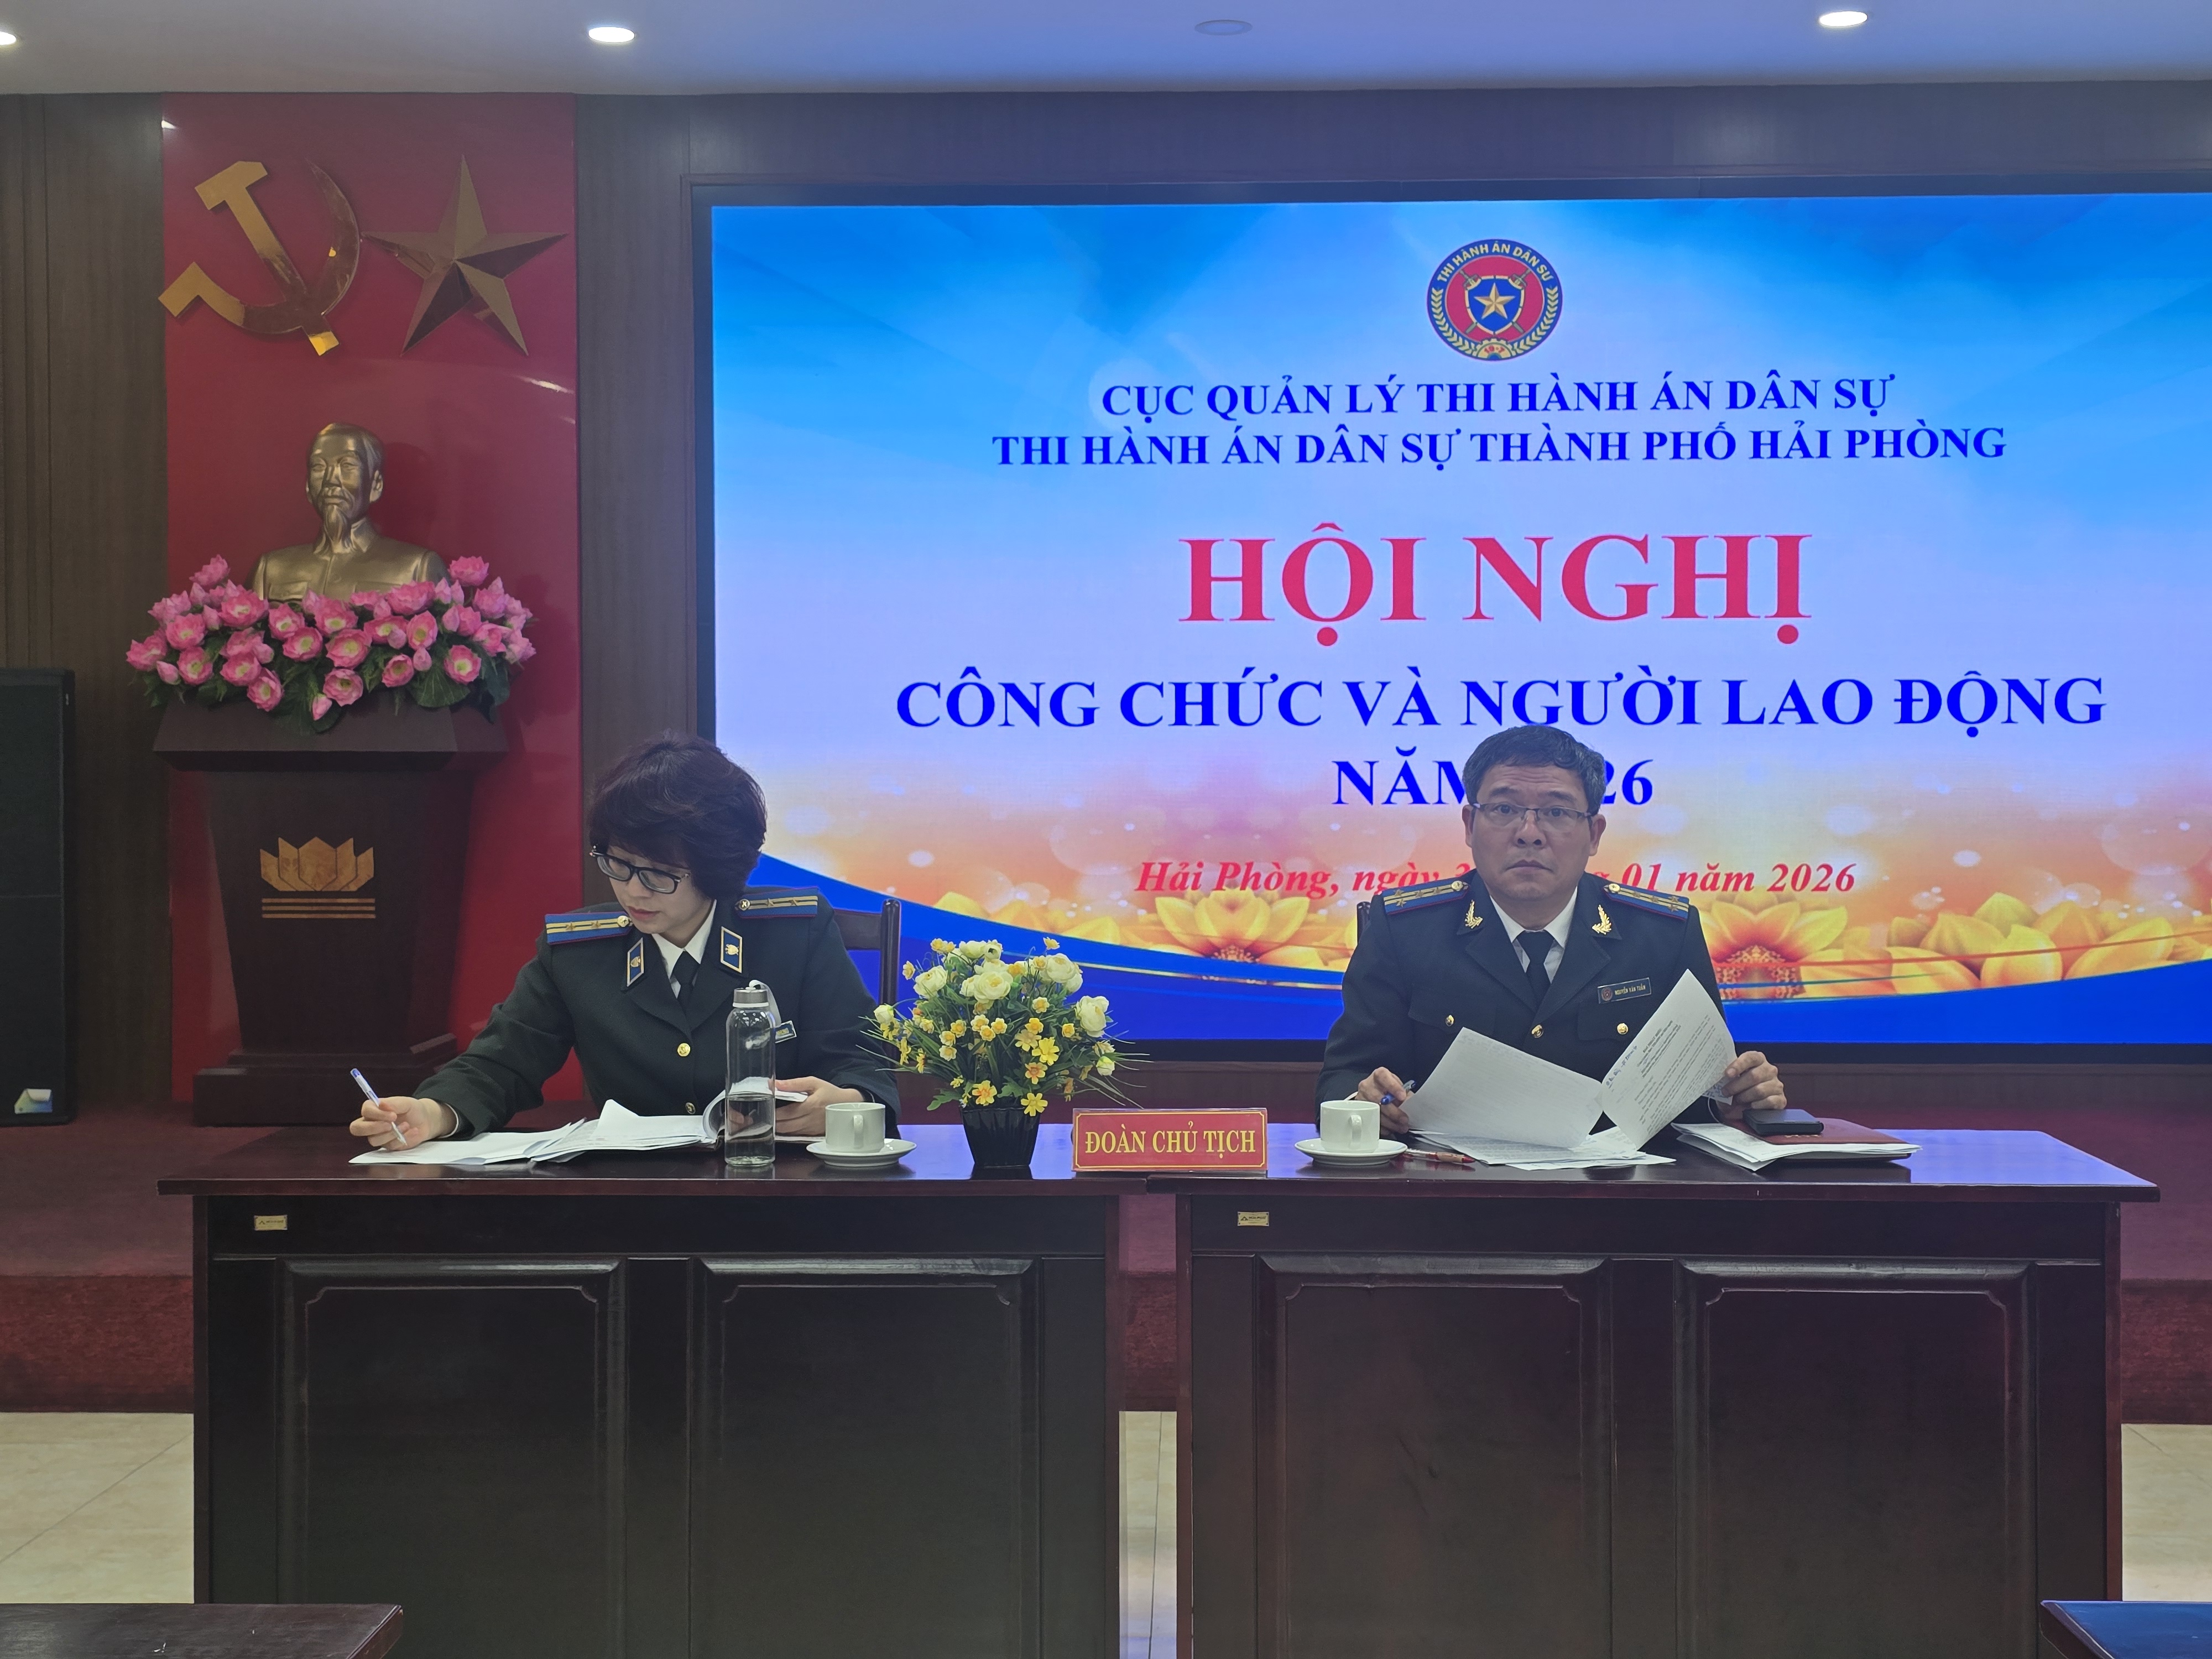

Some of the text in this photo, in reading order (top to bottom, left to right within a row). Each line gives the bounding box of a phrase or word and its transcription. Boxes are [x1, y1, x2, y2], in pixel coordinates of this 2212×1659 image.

[1437, 263, 1455, 282] THI
[1102, 369, 1896, 424] CỤC QUẢN LÝ THI HÀNH ÁN DÂN SỰ
[993, 419, 2007, 471] THI HÀNH ÁN DÂN SỰ THÀNH PHỐ HẢI PHÒNG
[1178, 522, 1812, 646] HỘI NGHỊ
[896, 665, 2107, 738] CÔNG CHỨC VÀ NGƯỜI LAO ĐỘNG
[1135, 860, 1204, 892] Hải
[1211, 860, 1338, 900] Phòng,
[1621, 863, 1661, 892] 01
[1674, 862, 1756, 892] năm
[1766, 863, 1858, 892] 2026
[1084, 1120, 1256, 1159] ĐOÀN CHỦ TỊCH
